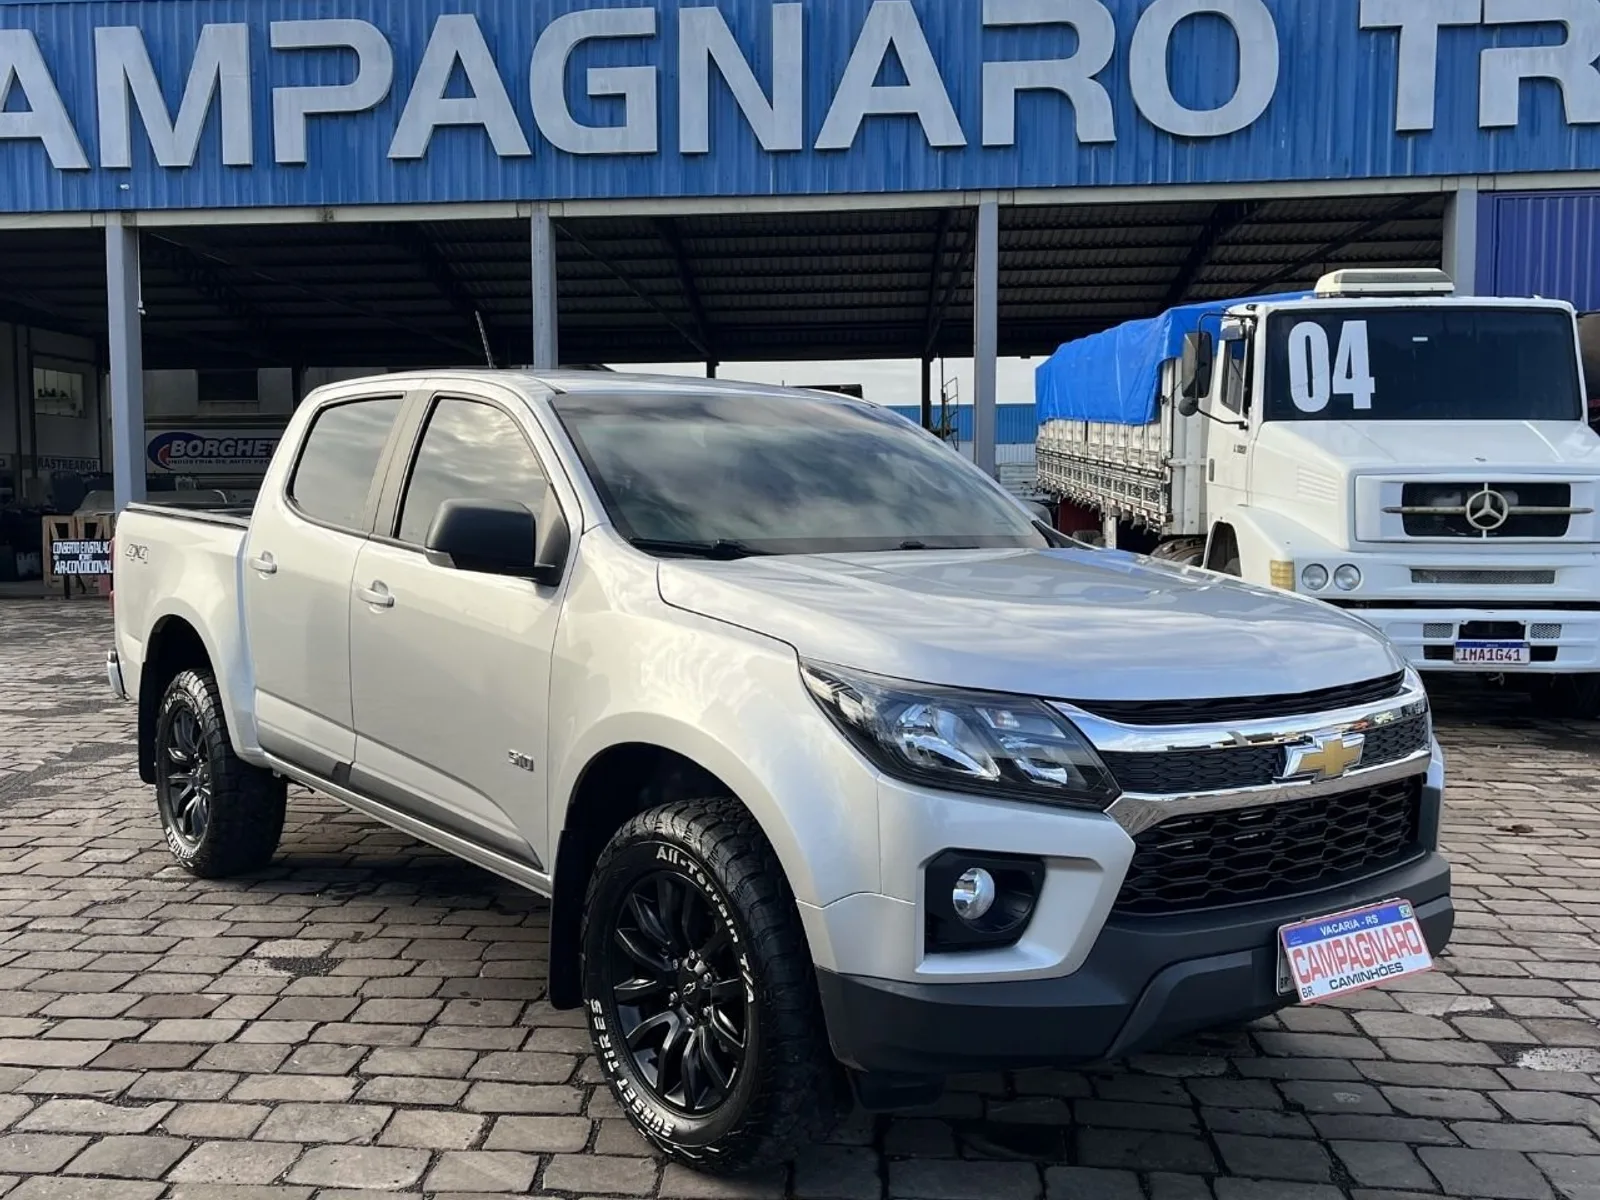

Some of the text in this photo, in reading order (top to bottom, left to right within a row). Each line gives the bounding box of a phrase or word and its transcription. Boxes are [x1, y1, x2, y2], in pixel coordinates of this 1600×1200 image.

[1288, 320, 1376, 413] 04
[1460, 648, 1521, 662] IMA1G41
[1320, 919, 1361, 937] VACARIA
[1366, 914, 1379, 926] RS
[1292, 921, 1423, 985] CAMPAGNARO
[1328, 963, 1405, 991] CAMINHÕES
[1301, 985, 1315, 999] BR
[616, 1077, 676, 1138] SUNSET
